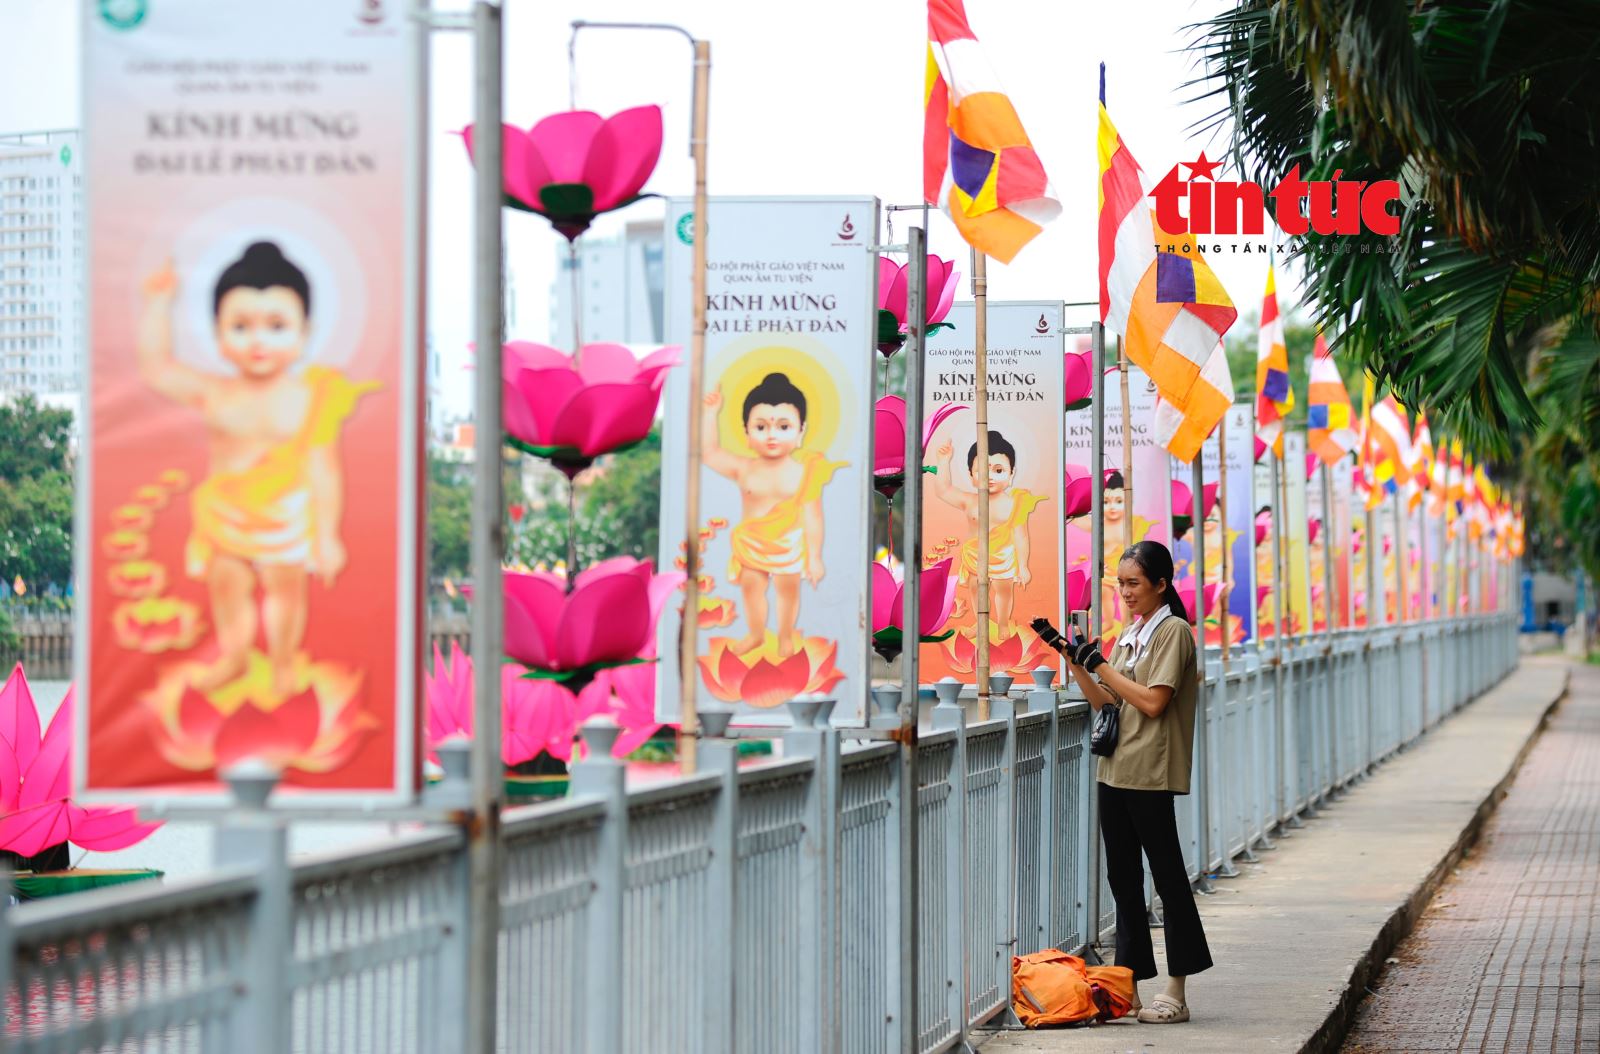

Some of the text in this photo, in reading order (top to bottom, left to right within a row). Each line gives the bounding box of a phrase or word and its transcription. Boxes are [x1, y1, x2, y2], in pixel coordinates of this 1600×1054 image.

[769, 260, 794, 271] GIÁO
[821, 262, 846, 271] NAM
[723, 274, 753, 284] QUAN
[705, 290, 837, 311] KÍNH MỪNG
[758, 315, 806, 335] PHẬT
[928, 348, 948, 356] GIÁO
[951, 358, 974, 366] QUAN
[985, 370, 1037, 386] MỪNG
[932, 391, 957, 403] ĐẠI
[986, 389, 1013, 404] HẬT
[1015, 388, 1044, 401] ĐẢN
[1070, 423, 1093, 436] KÍN
